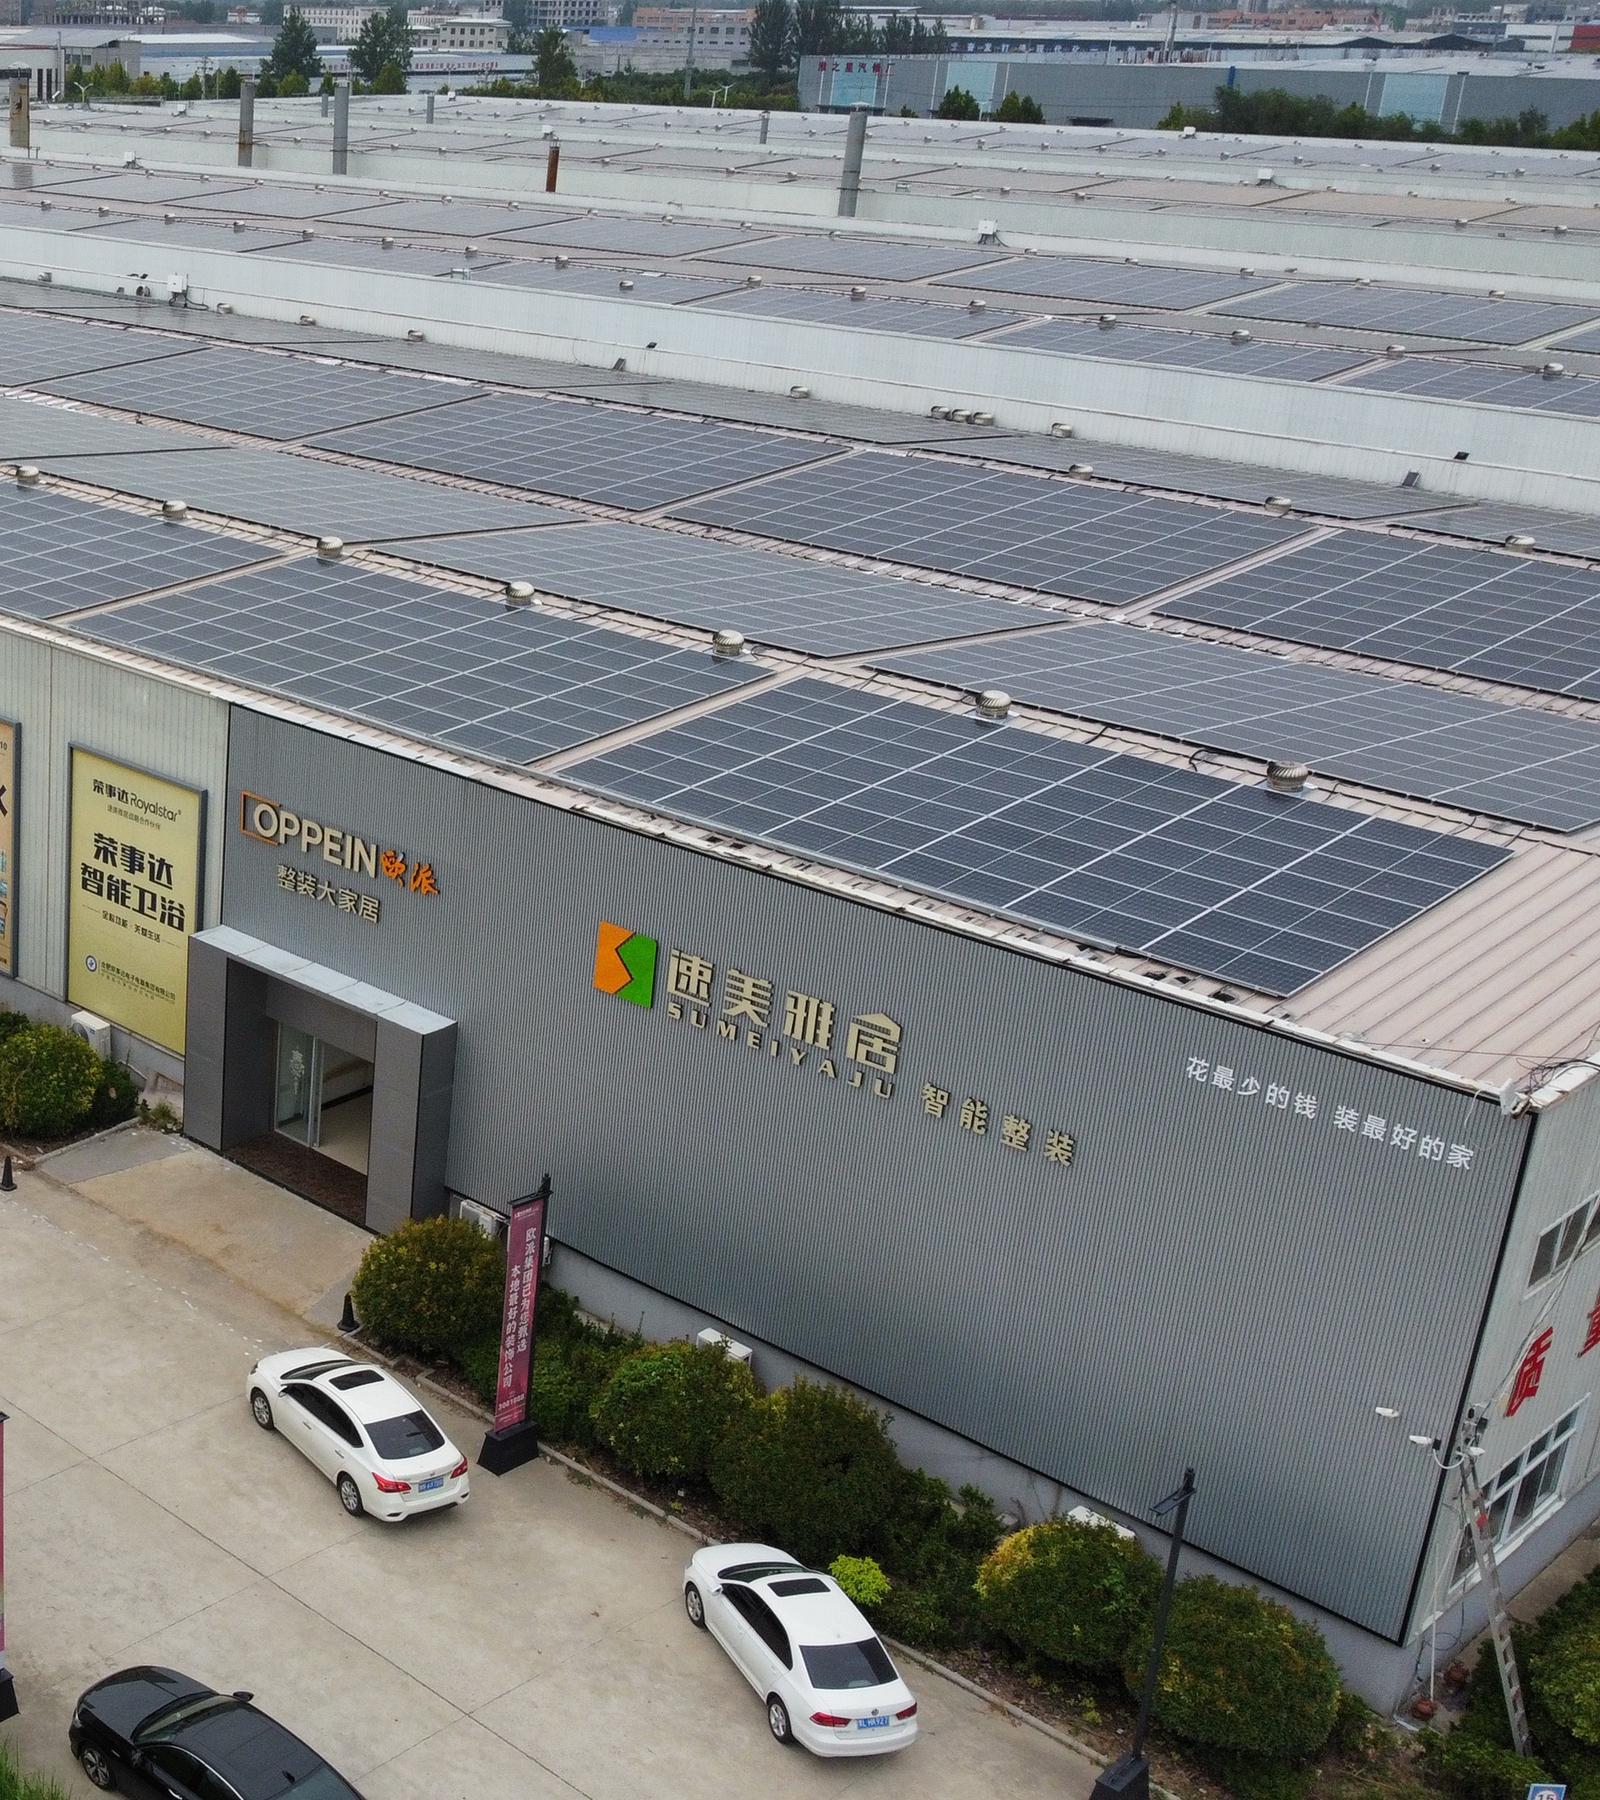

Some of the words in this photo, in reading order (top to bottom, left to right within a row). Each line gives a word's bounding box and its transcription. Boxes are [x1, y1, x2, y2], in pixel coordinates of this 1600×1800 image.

[92, 778, 129, 805] 荣事达
[93, 832, 174, 891] 荣事达
[253, 802, 378, 879] OPPEIN
[380, 849, 440, 896] 欧派
[80, 862, 186, 933] 智能卫浴
[276, 864, 381, 924] 整装大家居
[666, 948, 902, 1075] 速美雅居
[666, 1002, 895, 1099] SUMEIYAJU
[921, 1082, 1076, 1167] 智能整装
[1186, 1056, 1319, 1120] 花最少的钱
[1333, 1105, 1474, 1171] 装最好的家
[502, 1264, 521, 1388] 本地最好的装饰公司
